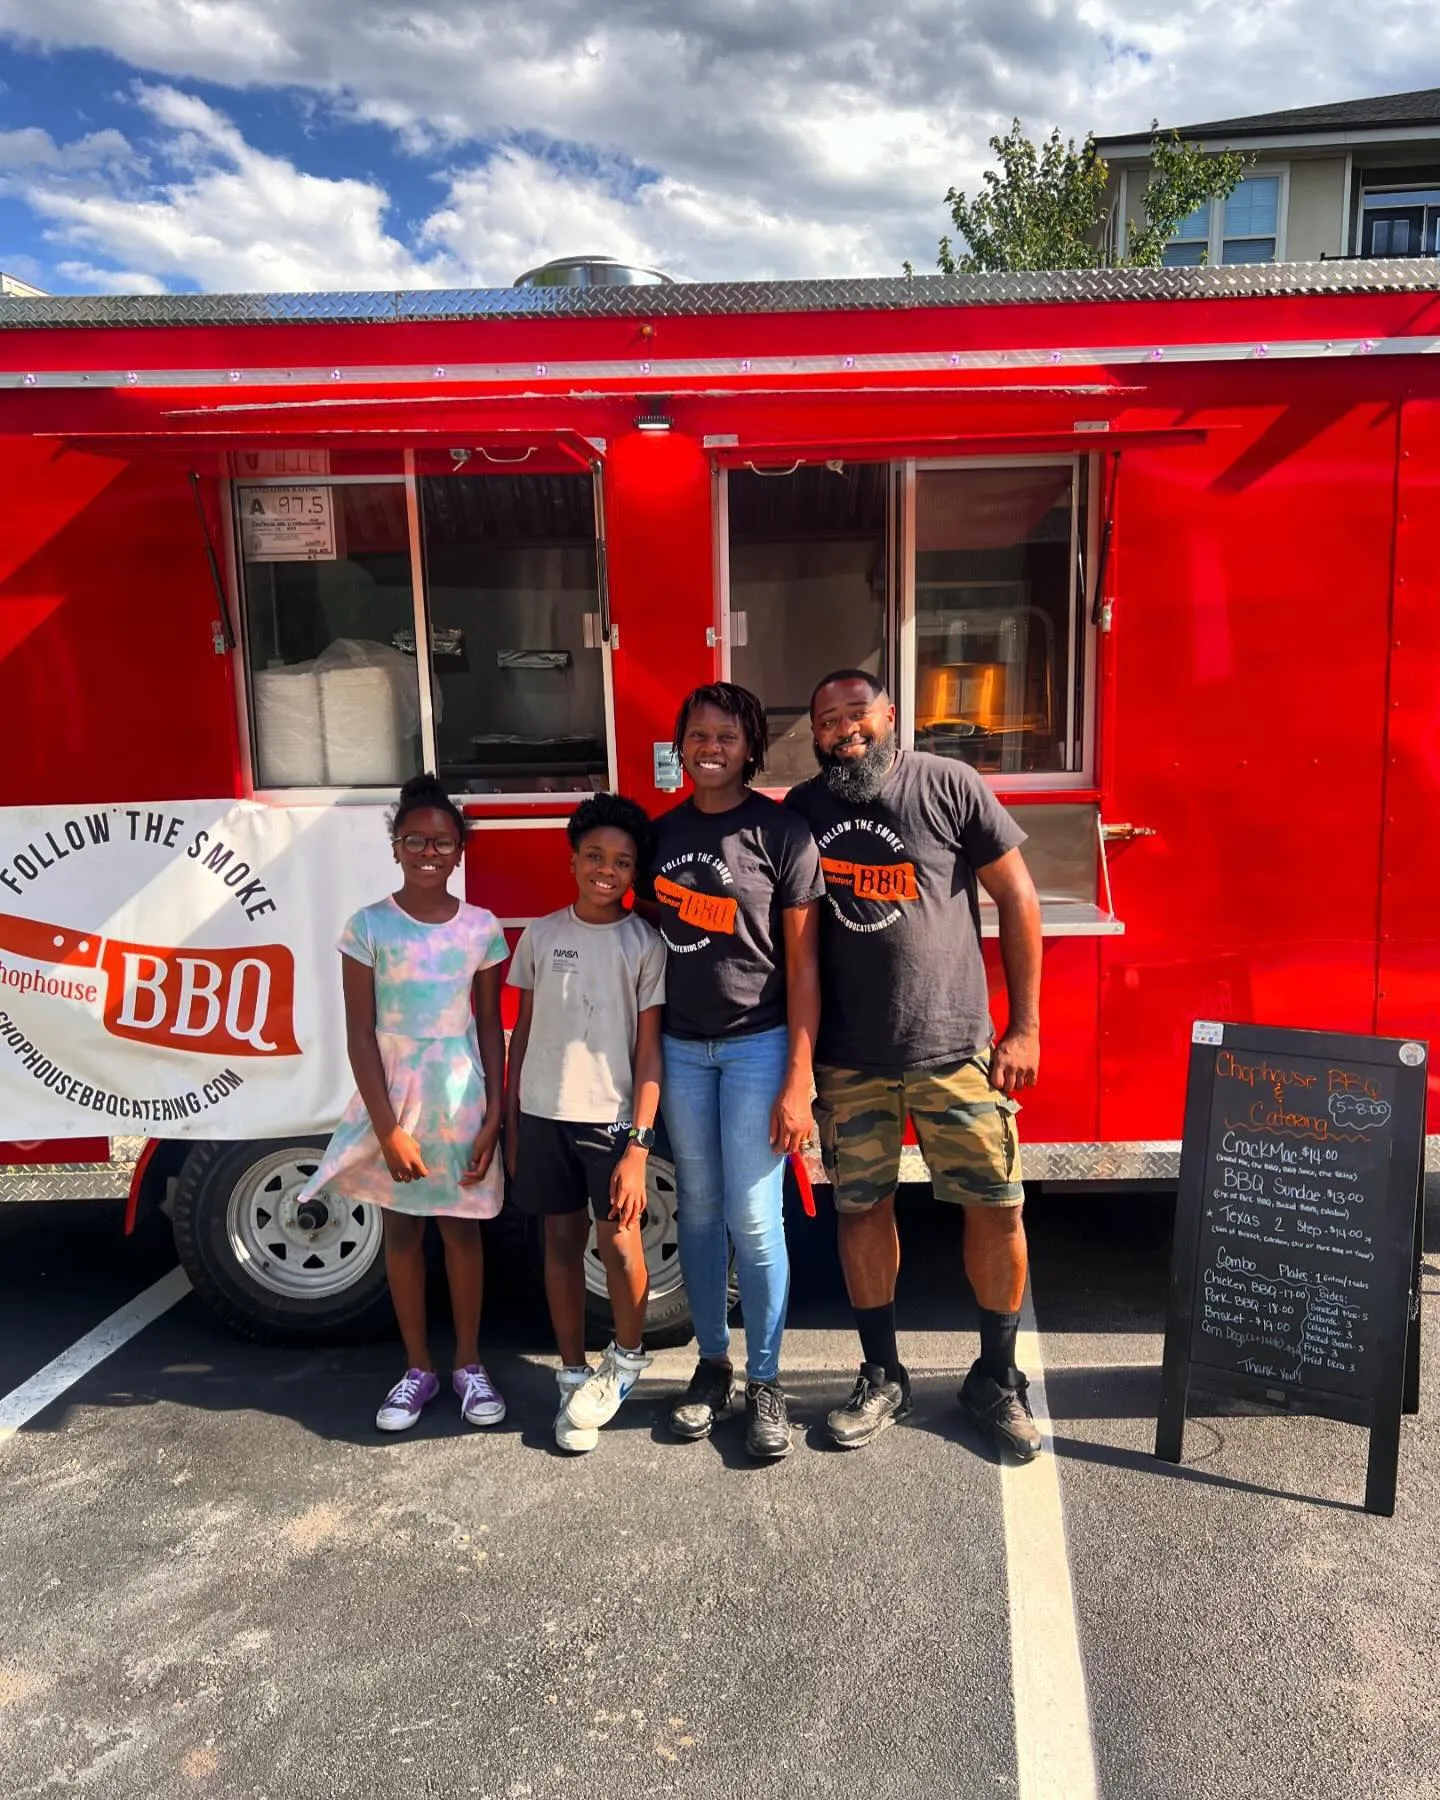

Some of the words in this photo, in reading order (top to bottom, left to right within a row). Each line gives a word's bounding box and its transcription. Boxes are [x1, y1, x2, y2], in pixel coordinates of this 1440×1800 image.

[250, 498, 266, 515] A
[279, 496, 324, 514] 97.5
[818, 820, 852, 849] FOLLOW
[855, 819, 875, 832] THE
[875, 823, 905, 853] SMOKE
[0, 812, 110, 895] FOLLOW
[126, 811, 184, 848] THE
[187, 830, 277, 922] SMOKE
[661, 852, 694, 873] FOLLOW
[697, 852, 713, 864] THE
[712, 858, 734, 885] SMOKE
[859, 868, 906, 897] BBQ
[553, 949, 578, 959] NASA
[117, 952, 278, 1051] BBQ
[607, 1120, 632, 1133] NAS
[1224, 1167, 1264, 1195] BBQ
[1273, 1177, 1321, 1201] Sundae
[1219, 1204, 1260, 1227] Texas
[1274, 1216, 1285, 1232] 2
[1296, 1219, 1322, 1238] Step
[1217, 1246, 1256, 1271] Combo
[1204, 1268, 1247, 1293] Chicken
[1252, 1281, 1277, 1299] BBQ
[1204, 1304, 1245, 1324] Brisket
[1205, 1287, 1232, 1304] Pork
[1234, 1296, 1259, 1312] BBQ
[1201, 1319, 1223, 1338] Corn
